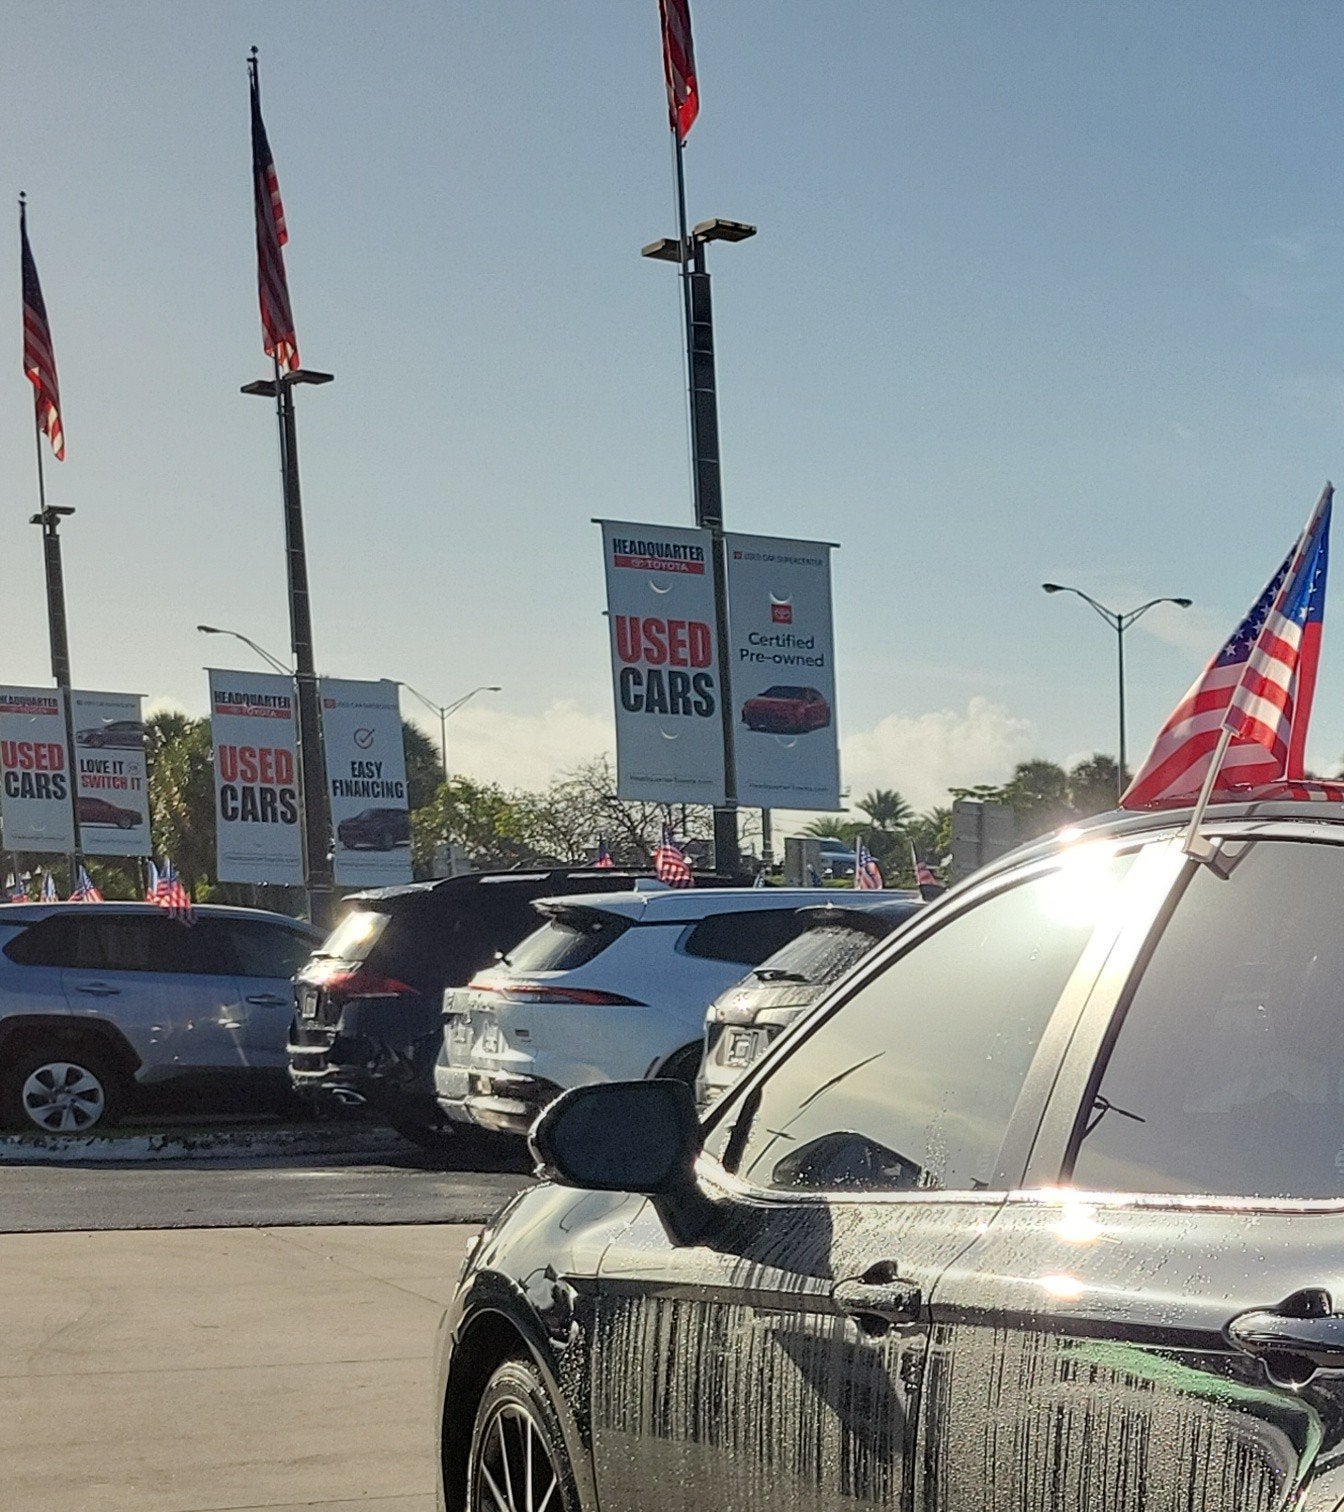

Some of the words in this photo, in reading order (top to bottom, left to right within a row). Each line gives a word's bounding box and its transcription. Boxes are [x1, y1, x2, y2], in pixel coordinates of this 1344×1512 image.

[613, 538, 704, 561] HEADQUARTER
[646, 560, 689, 572] TOYOTA
[615, 615, 712, 669] USED
[748, 632, 815, 650] Certified
[739, 648, 825, 667] Pre-owned
[619, 667, 716, 718] CARS
[1, 740, 64, 771] USED
[218, 744, 294, 785] USED
[80, 759, 110, 774] LOVE
[113, 761, 124, 775] IT
[350, 761, 383, 779] EASY
[4, 771, 68, 800] CARS
[81, 775, 128, 790] SWITCH
[131, 777, 142, 791] IT
[332, 779, 405, 799] FINANCING
[220, 784, 298, 824] CARS
